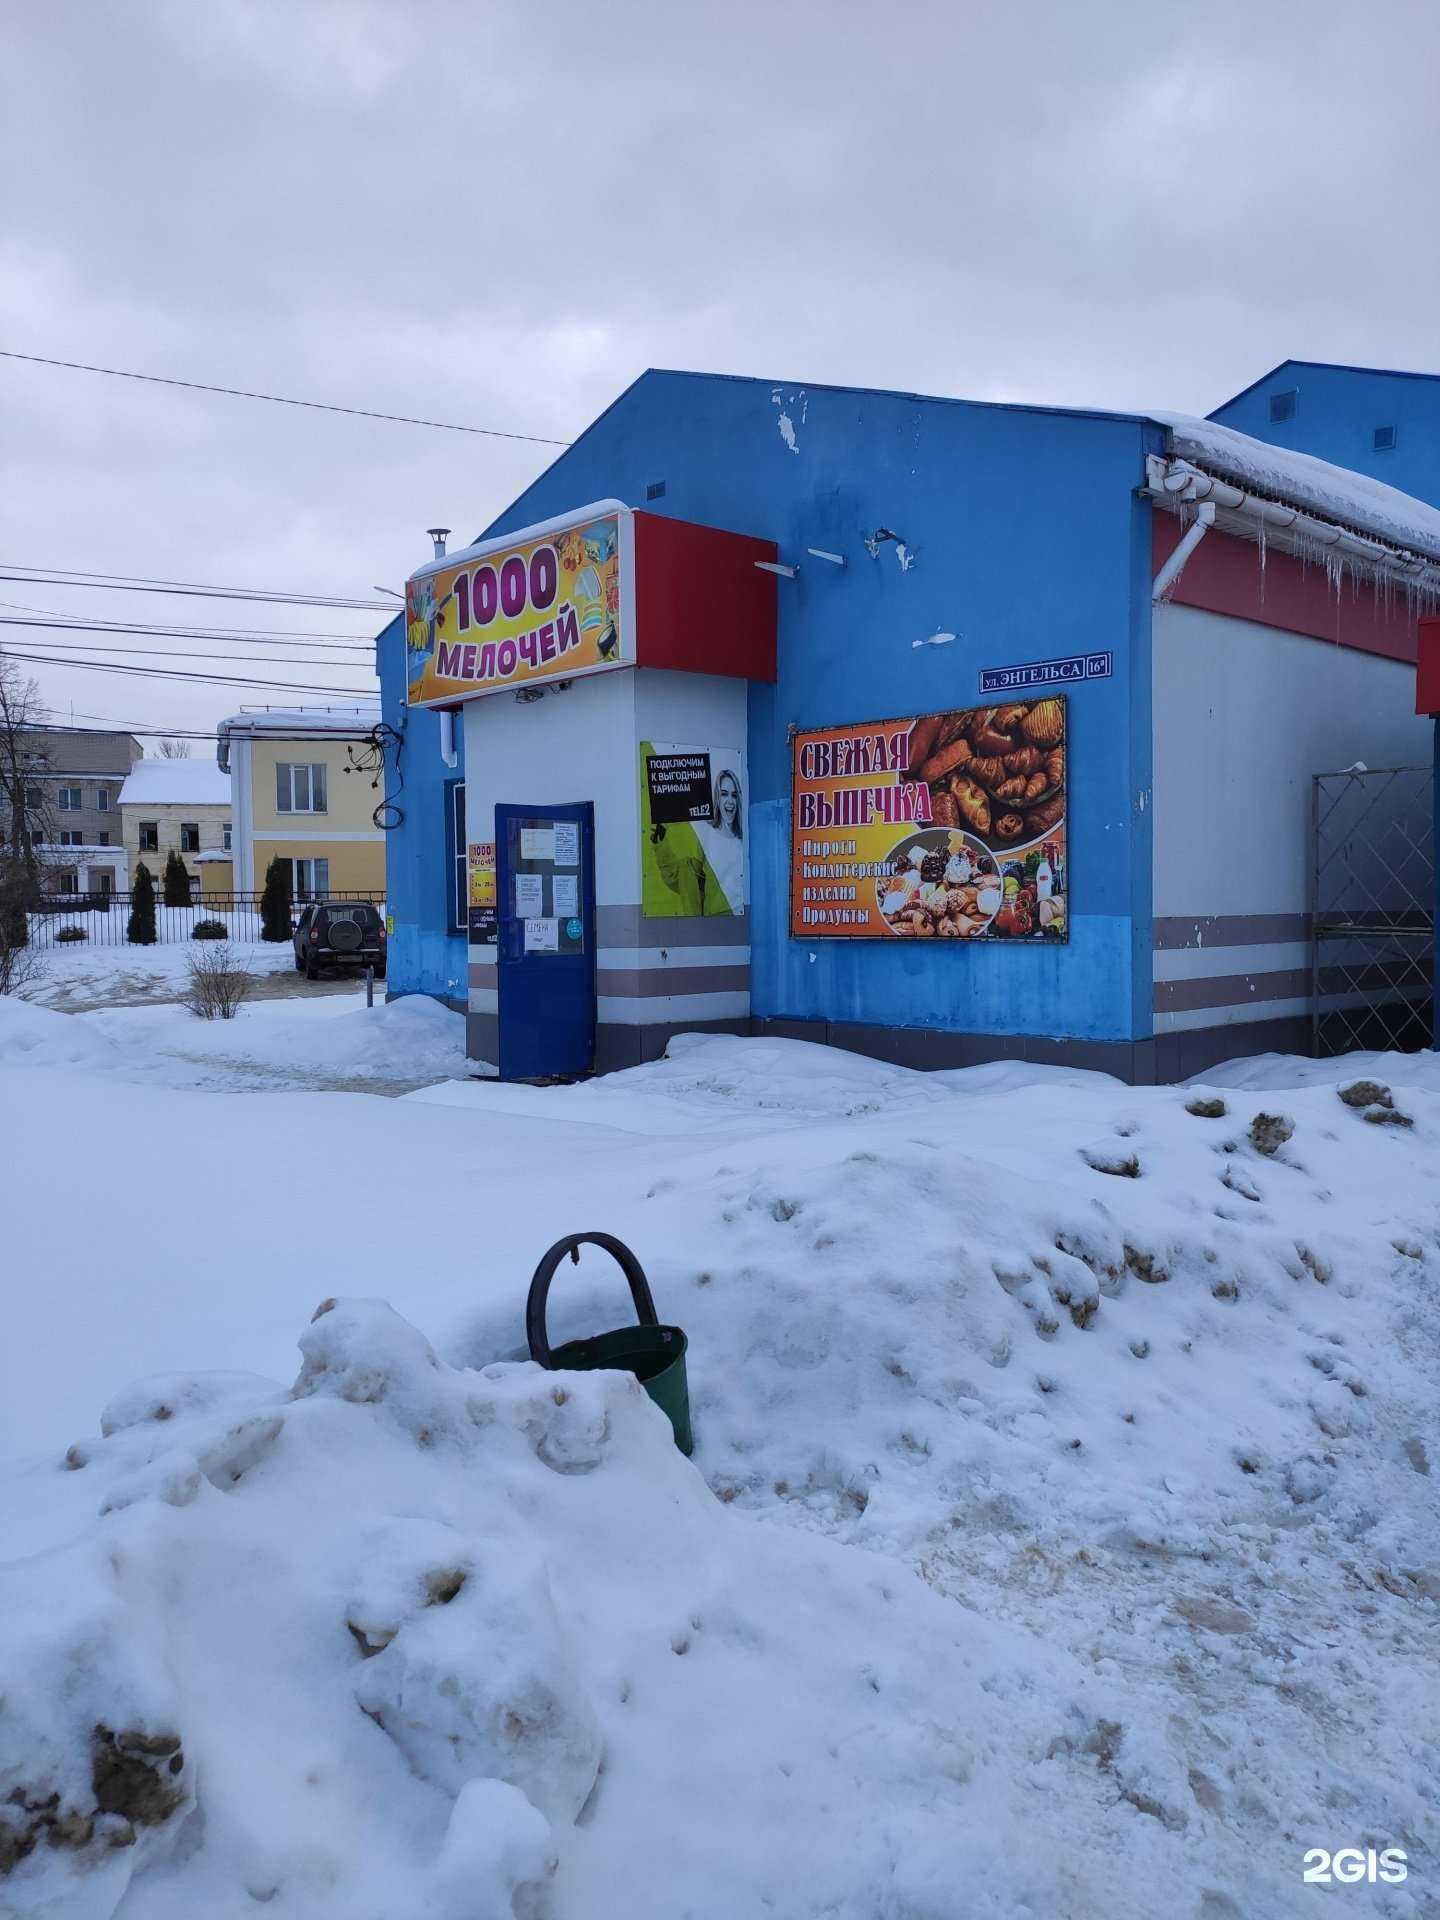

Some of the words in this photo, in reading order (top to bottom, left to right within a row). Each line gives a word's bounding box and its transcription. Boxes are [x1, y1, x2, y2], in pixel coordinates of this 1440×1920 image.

[453, 545, 559, 632] 1000
[437, 603, 580, 679] МЕЛОЧЕЙ
[1000, 663, 1081, 685] ЭНГЕЛЬСА
[650, 758, 705, 770] ПОДКЛЮЧИМ
[800, 732, 910, 780] СВЕЖАЯ
[651, 772, 657, 782] К
[658, 770, 706, 782] ВЫГОДНЫМ
[652, 783, 691, 794] ТАРИФАМ
[689, 803, 711, 816] TELE2
[798, 781, 933, 829] ВЫПЕЧКА
[803, 839, 856, 858] Пироги
[803, 861, 898, 880] Кондитерские
[803, 886, 856, 901] изделия
[802, 906, 869, 925] Продукты
